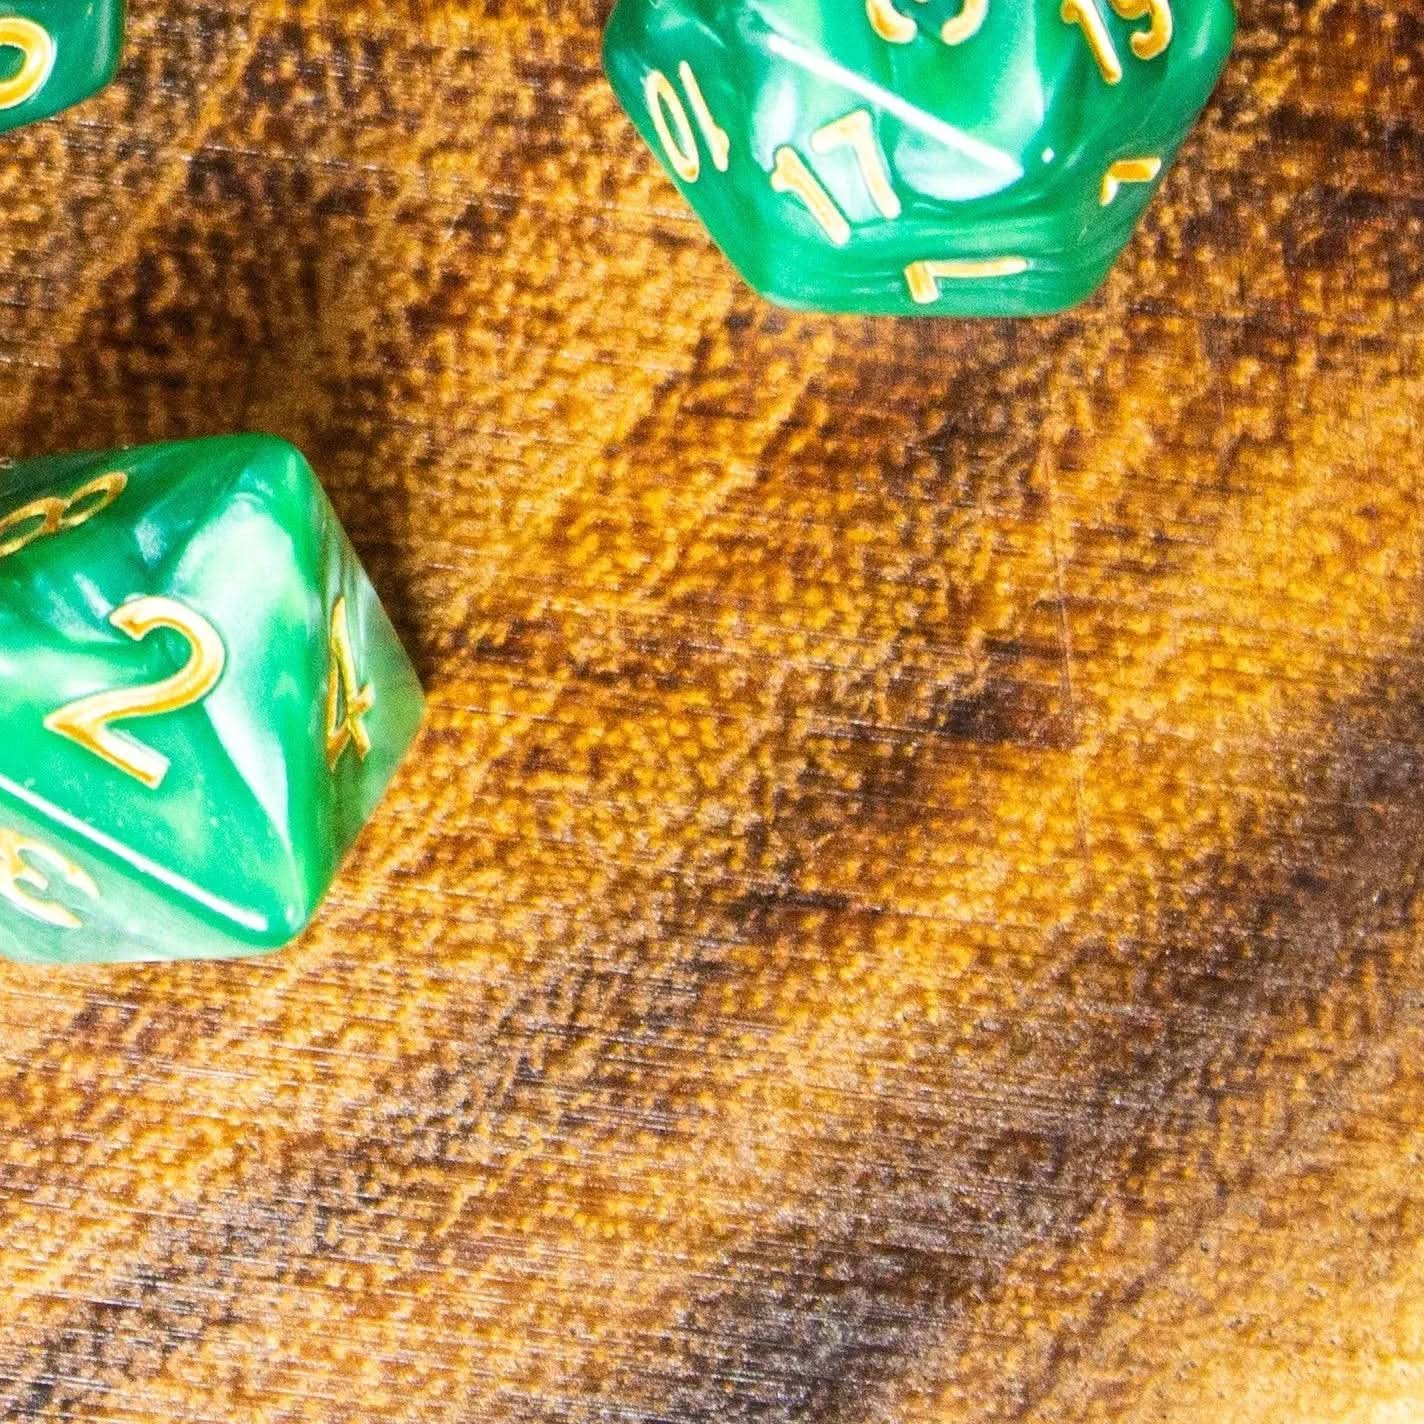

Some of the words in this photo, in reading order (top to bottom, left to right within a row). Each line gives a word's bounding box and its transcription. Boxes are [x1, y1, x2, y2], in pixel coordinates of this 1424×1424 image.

[645, 60, 730, 183] 10
[771, 108, 901, 247] 17
[43, 596, 226, 790] 2
[326, 596, 373, 773] 4
